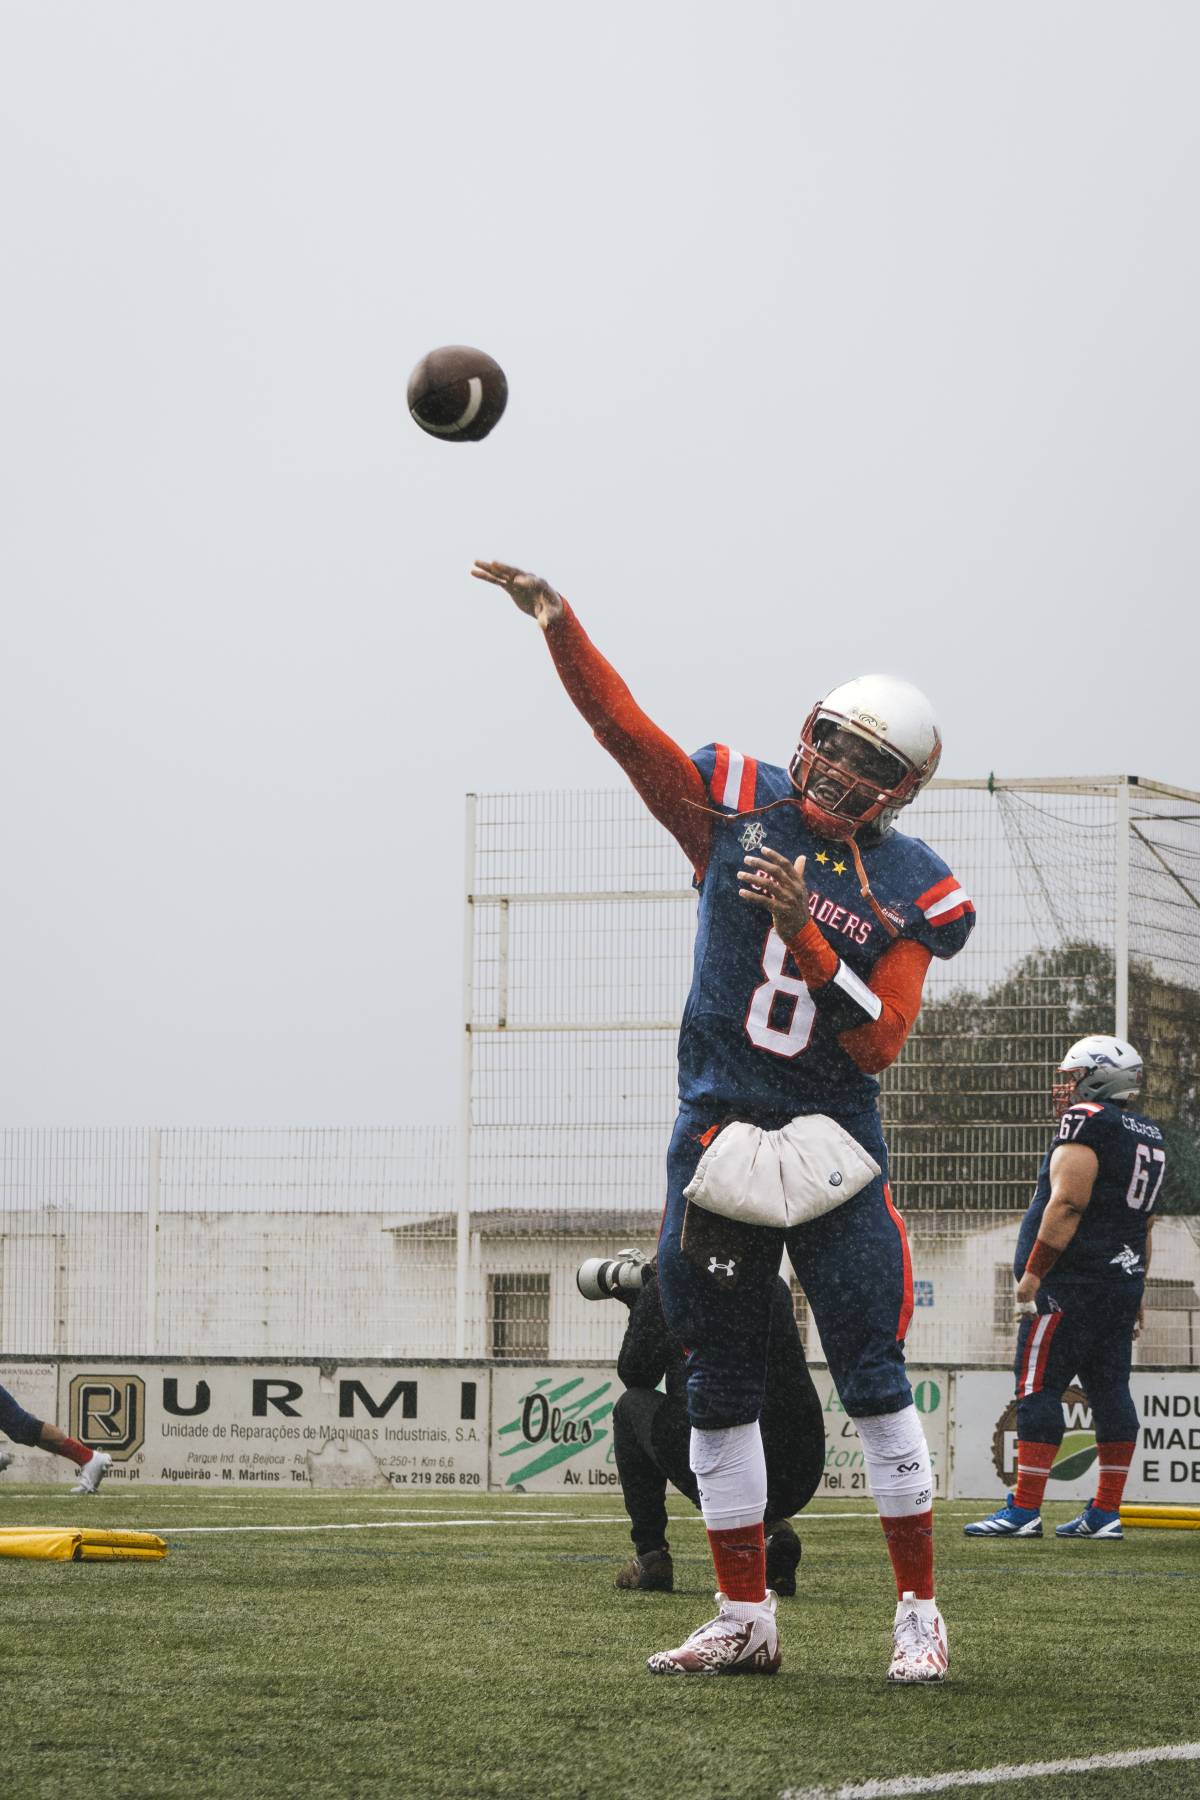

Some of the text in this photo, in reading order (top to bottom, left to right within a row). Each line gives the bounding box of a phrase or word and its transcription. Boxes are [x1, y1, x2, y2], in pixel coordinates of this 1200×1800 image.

[744, 924, 817, 1061] 8
[1059, 1113, 1086, 1140] 67
[1126, 1143, 1166, 1212] 67
[161, 1424, 209, 1438] Unidade
[212, 1424, 227, 1438] de
[230, 1424, 300, 1442] Reparações
[303, 1425, 316, 1439] de
[385, 1427, 450, 1443] Industriais,
[455, 1427, 480, 1442] S.A.
[161, 1467, 211, 1483] Algueirão
[222, 1469, 236, 1480] M.
[238, 1469, 280, 1481] Martins
[388, 1472, 408, 1484] Fax
[411, 1472, 432, 1484] 219
[435, 1472, 456, 1485] 266
[459, 1473, 480, 1485] 820
[563, 1469, 584, 1485] Av.
[823, 1473, 845, 1489] Tel.
[1143, 1460, 1160, 1483] E
